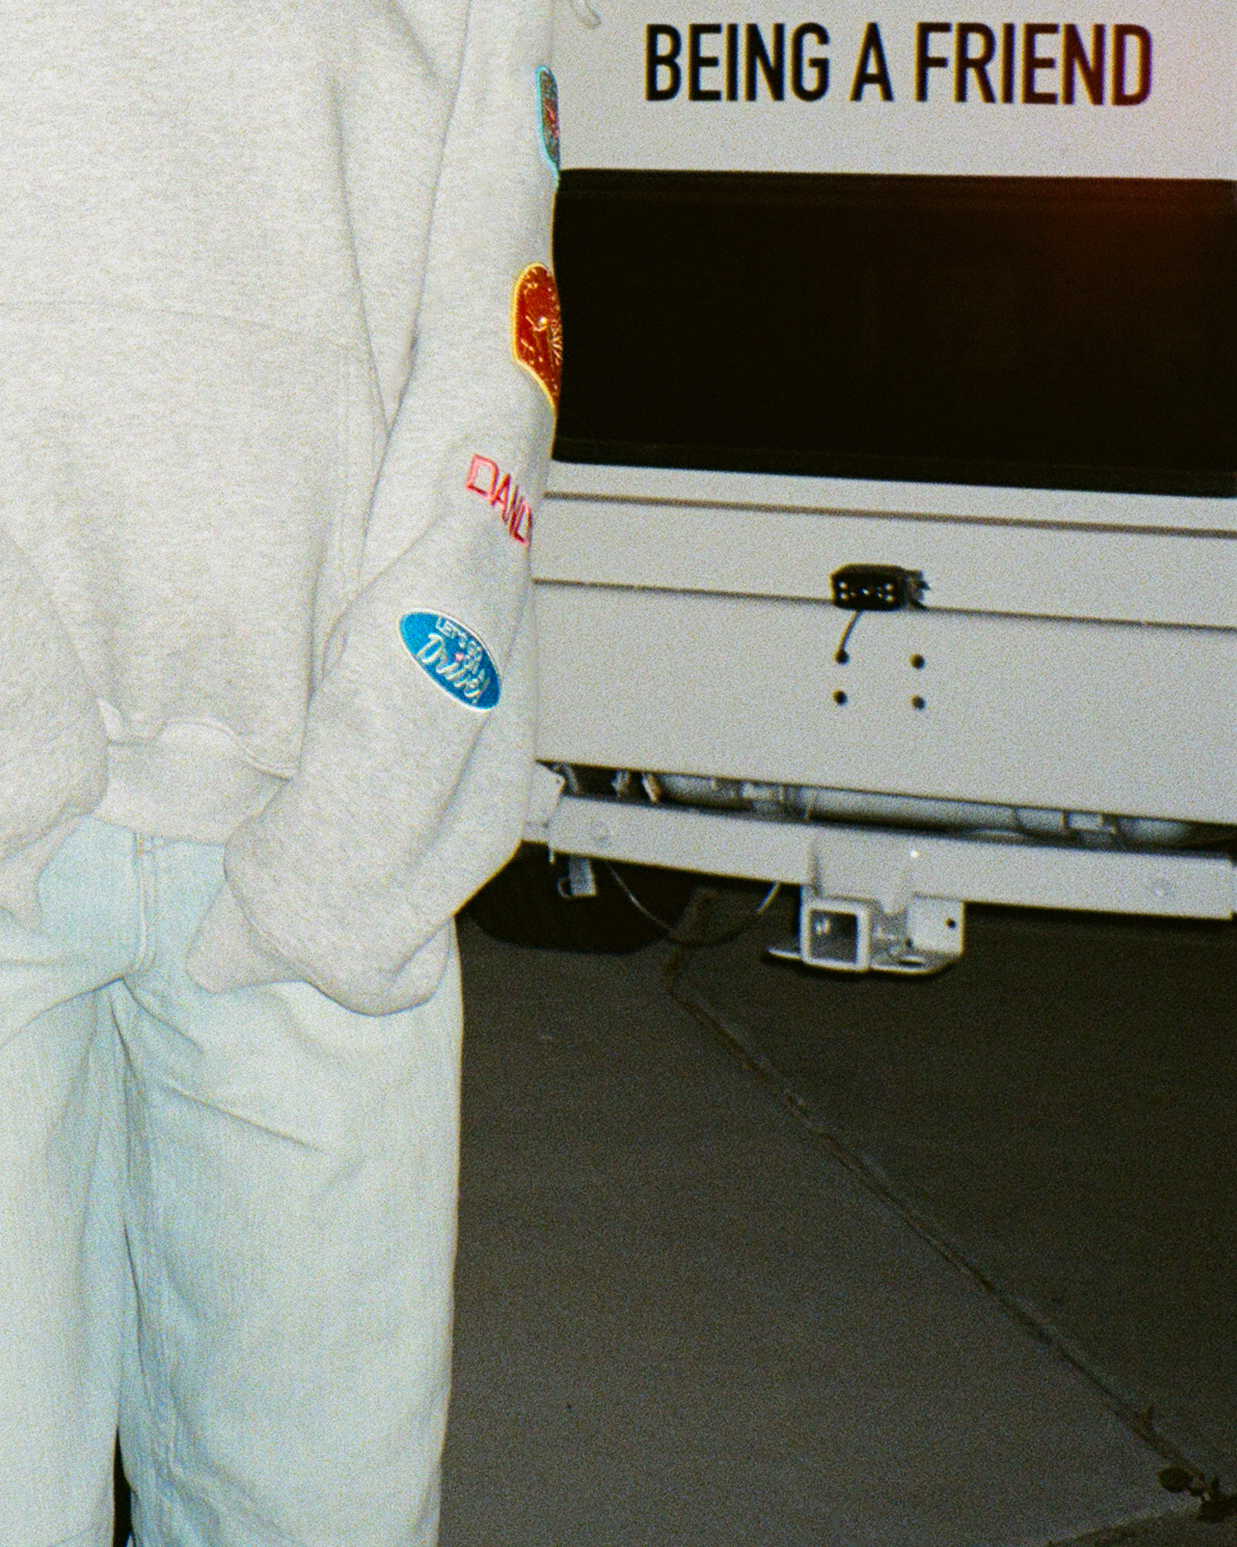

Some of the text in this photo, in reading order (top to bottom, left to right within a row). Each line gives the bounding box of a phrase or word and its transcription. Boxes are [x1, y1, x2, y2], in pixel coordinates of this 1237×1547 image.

[645, 21, 1154, 106] BEING A FRIEND
